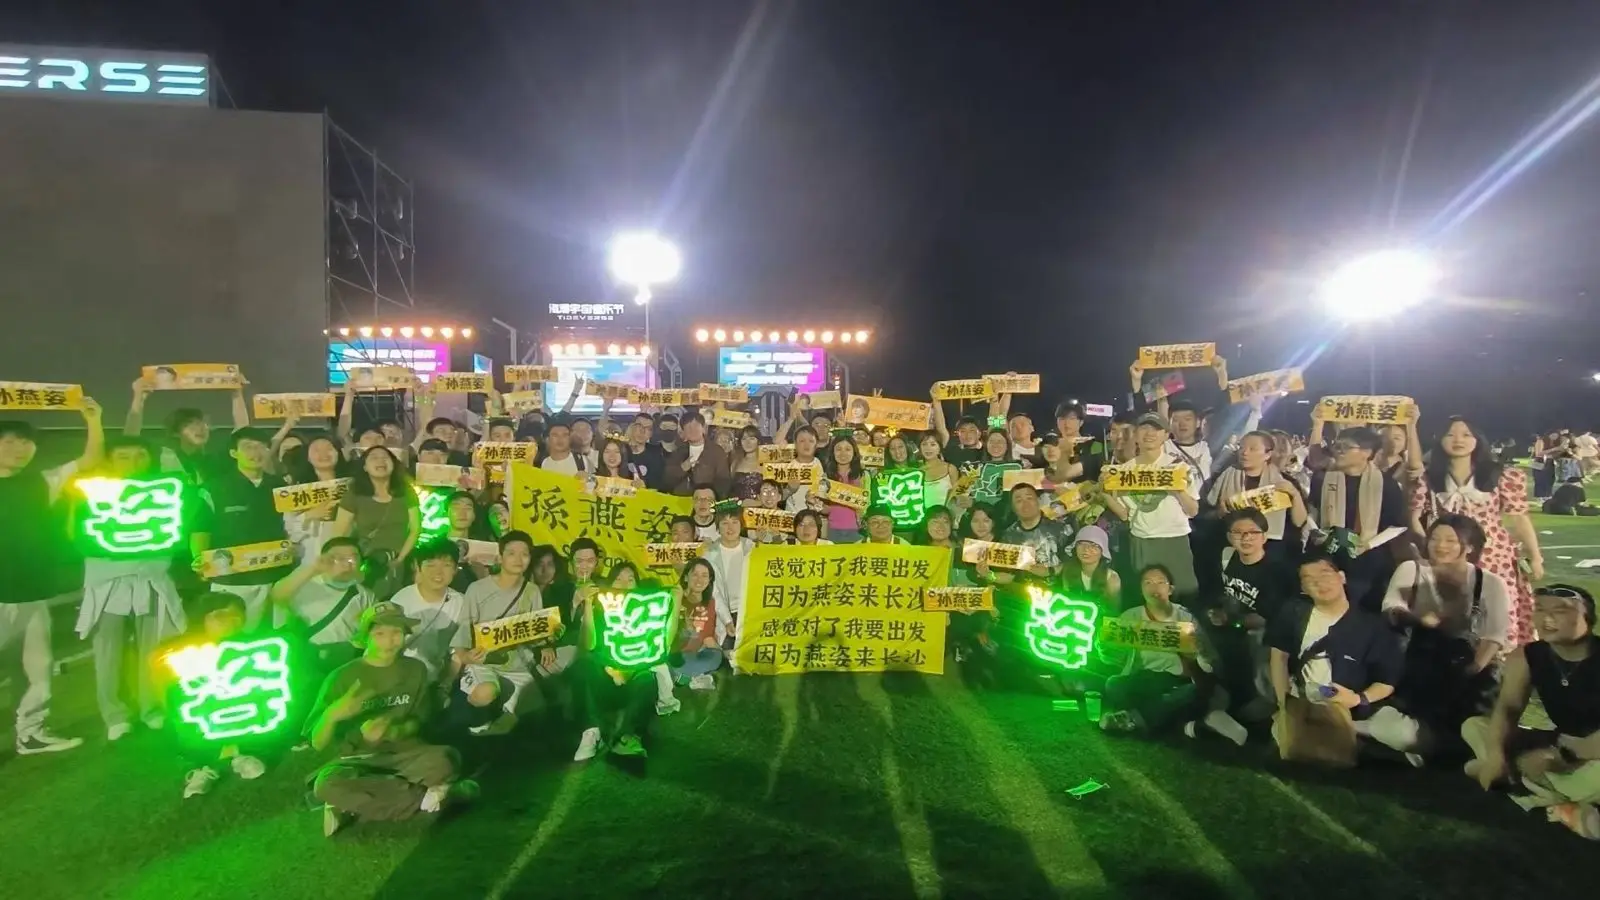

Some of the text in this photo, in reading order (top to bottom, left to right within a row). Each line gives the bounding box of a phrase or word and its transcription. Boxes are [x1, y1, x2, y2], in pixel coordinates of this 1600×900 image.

[1155, 350, 1204, 365] 孙燕姿
[446, 377, 485, 391] 孙燕姿
[946, 383, 985, 397] 孙燕姿
[638, 391, 673, 404] 孙燕姿
[1335, 403, 1398, 421] 孙燕姿
[485, 446, 527, 460] 孙燕姿
[774, 467, 812, 481] 孙燕姿
[1119, 469, 1174, 487] 孙燕姿
[755, 512, 794, 529] 孙燕姿
[655, 546, 697, 562] 孙燕姿
[764, 556, 930, 580] 感觉对了我要出发
[762, 583, 925, 612] 因为燕姿来长沙
[937, 592, 983, 608] 孙燕姿
[493, 616, 550, 644] 孙燕姿
[759, 616, 927, 643] 感觉对了我要出发
[1119, 625, 1181, 649] 孙燕姿
[754, 643, 927, 669] 因为燕姿来长沙
